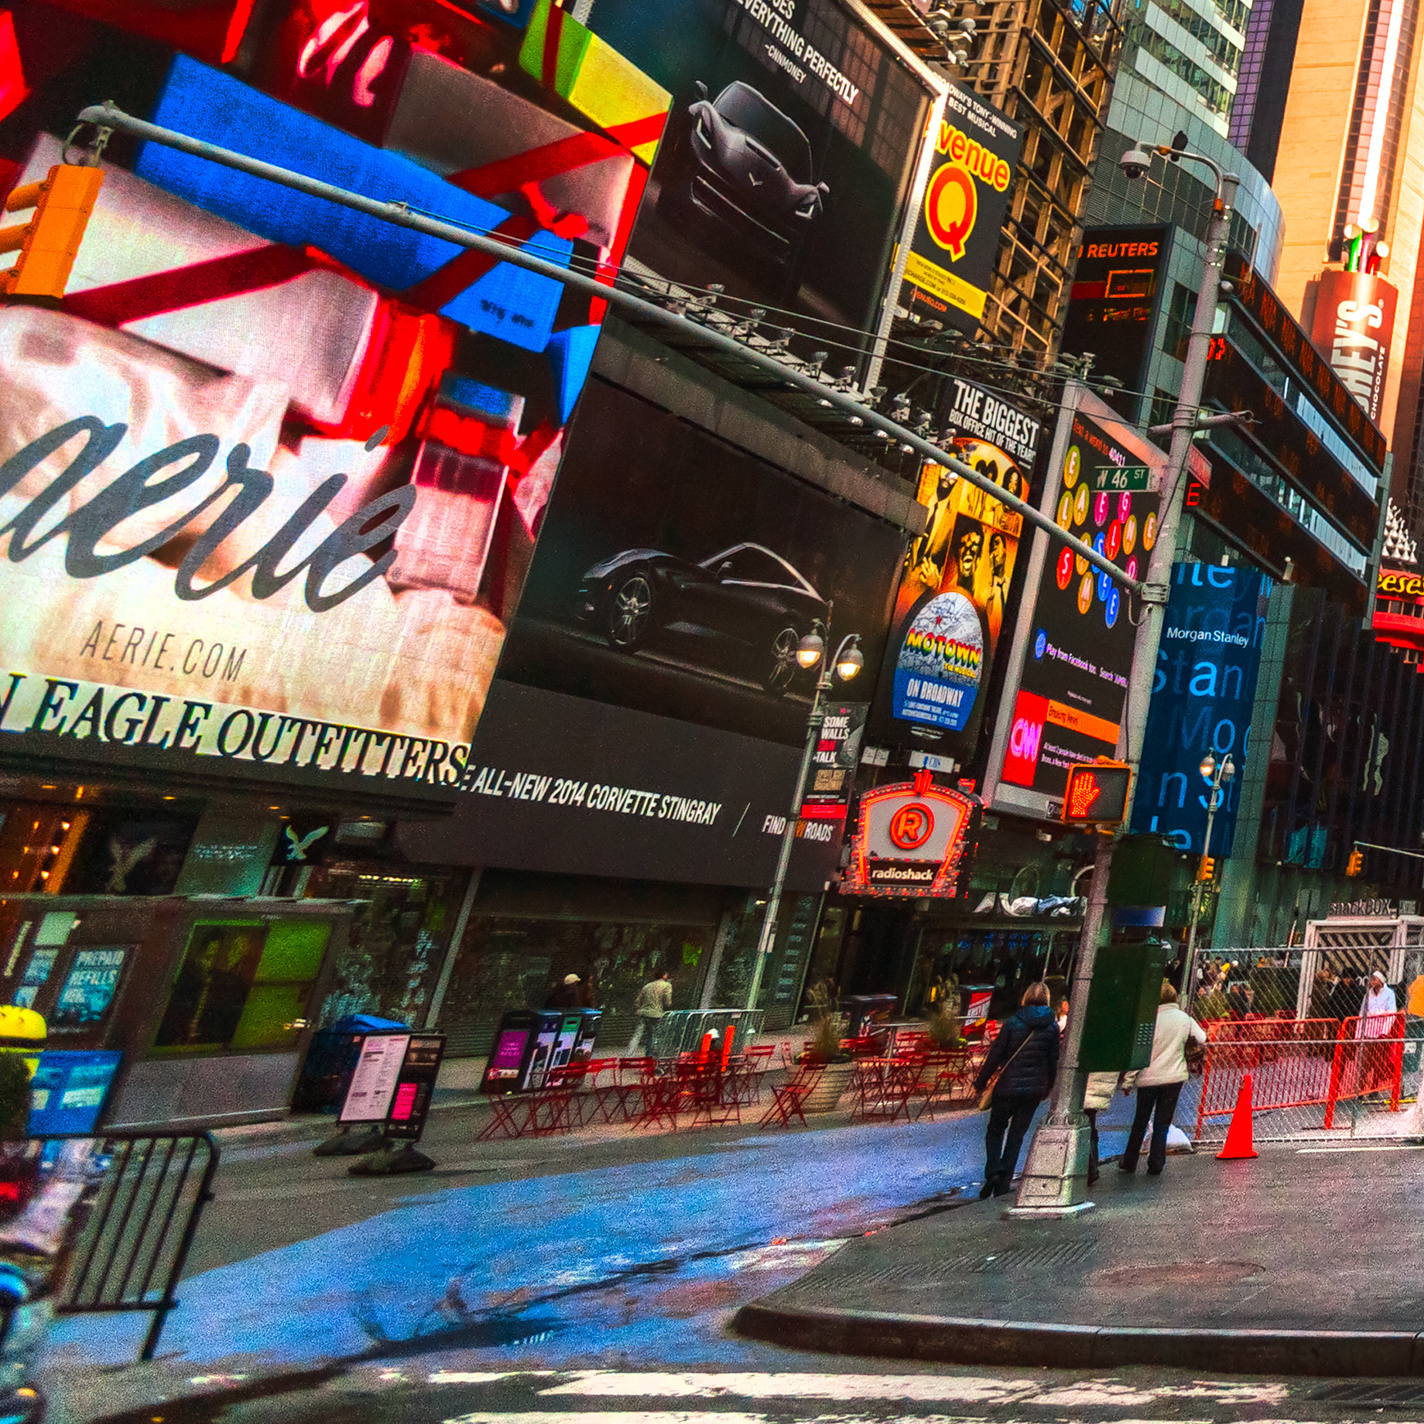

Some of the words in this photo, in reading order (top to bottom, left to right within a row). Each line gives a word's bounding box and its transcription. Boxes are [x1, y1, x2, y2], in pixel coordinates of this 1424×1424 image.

[799, 45, 860, 104] PERFECTLY
[949, 98, 967, 118] BEST
[967, 111, 996, 138] MUSICAL
[925, 161, 978, 262] Q
[1087, 241, 1158, 259] REUTERS
[1370, 346, 1386, 421] CHOCOLATE
[950, 408, 963, 423] BOX
[963, 414, 985, 435] OFFICE
[985, 426, 997, 441] HIT
[997, 432, 1005, 445] OF
[1005, 436, 1017, 452] THE
[983, 395, 1040, 448] BIGGEST
[1111, 471, 1128, 489] 46
[1134, 469, 1146, 480] ST
[0, 415, 417, 612] aerie
[81, 620, 248, 683] AERIE.COM
[906, 628, 981, 669] MOTOWN
[1167, 627, 1211, 641] Morgan
[1212, 630, 1249, 648] Stanley
[907, 678, 920, 697] ON
[921, 681, 964, 708] BROADWAY
[30, 679, 209, 754] EAGLE
[217, 709, 469, 784] OUTFITTERS
[821, 728, 850, 740] WALLS
[823, 716, 850, 728] SOME
[1010, 717, 1043, 762] CNN
[815, 751, 837, 763] TALK
[470, 766, 552, 806] ALL-NEW
[549, 778, 588, 809] 2014
[586, 782, 660, 819] CORVETTE
[659, 793, 723, 826] STINGRAY
[762, 814, 787, 834] FIND
[804, 822, 834, 841] ROADS
[872, 867, 934, 881] radioshack
[78, 951, 125, 967] PREPAID
